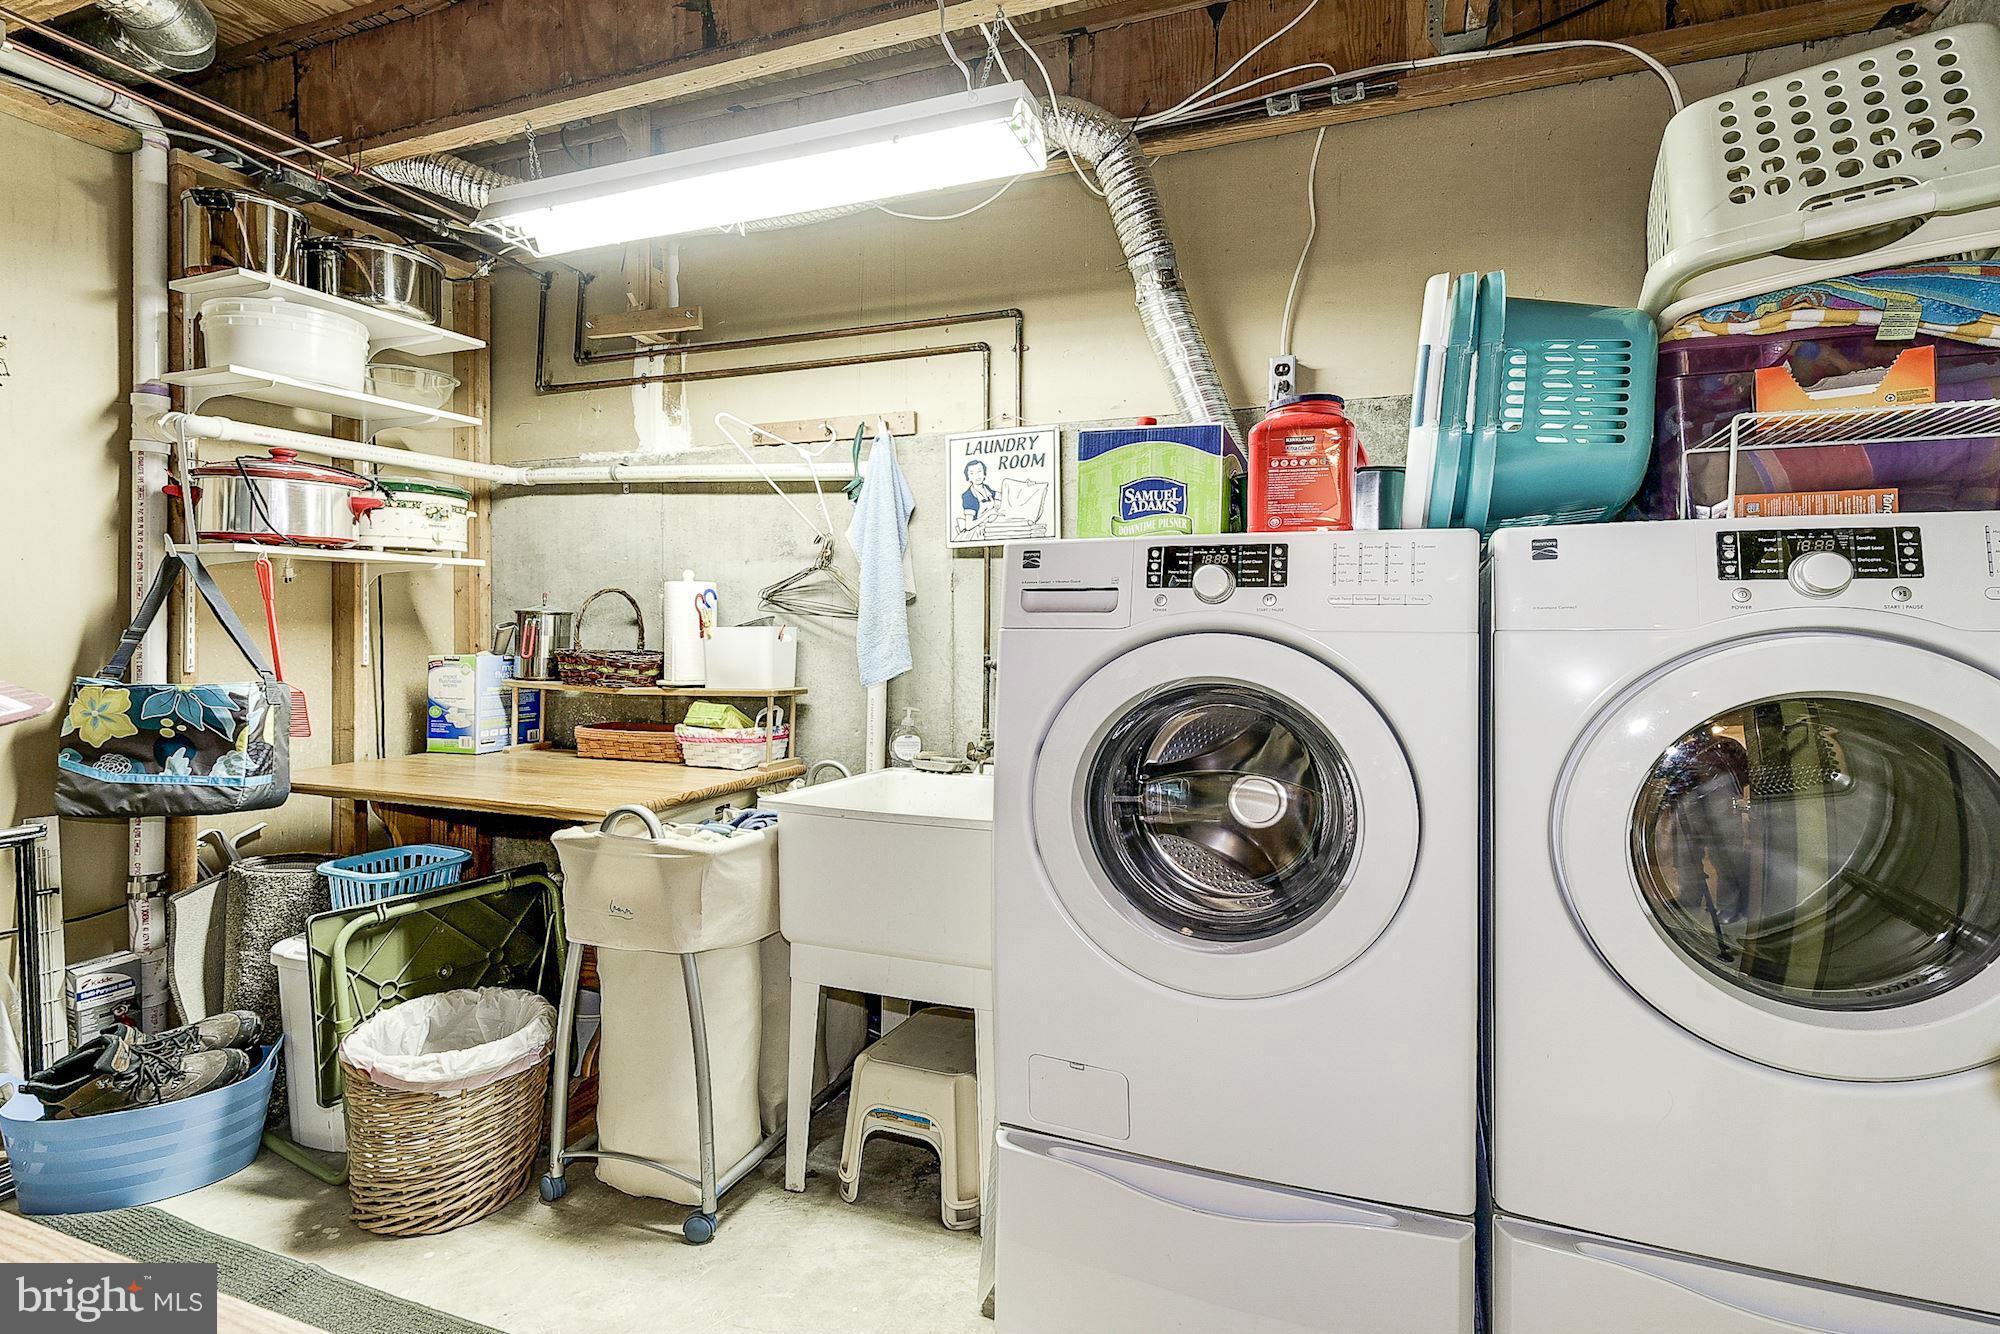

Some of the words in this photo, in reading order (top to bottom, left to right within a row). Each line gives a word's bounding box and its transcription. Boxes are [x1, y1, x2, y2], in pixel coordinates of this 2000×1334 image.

[965, 435, 1040, 456] LAUNDRY
[998, 453, 1046, 470] ROOM
[1124, 487, 1182, 503] SAMUEL
[1128, 500, 1178, 515] ADAMS
[1118, 520, 1157, 535] DOWNTIME
[1158, 518, 1188, 529] PILSNER
[1796, 540, 1835, 551] 18:88
[1201, 554, 1229, 565] 18:88
[80, 983, 118, 1000] Multi-Purpose
